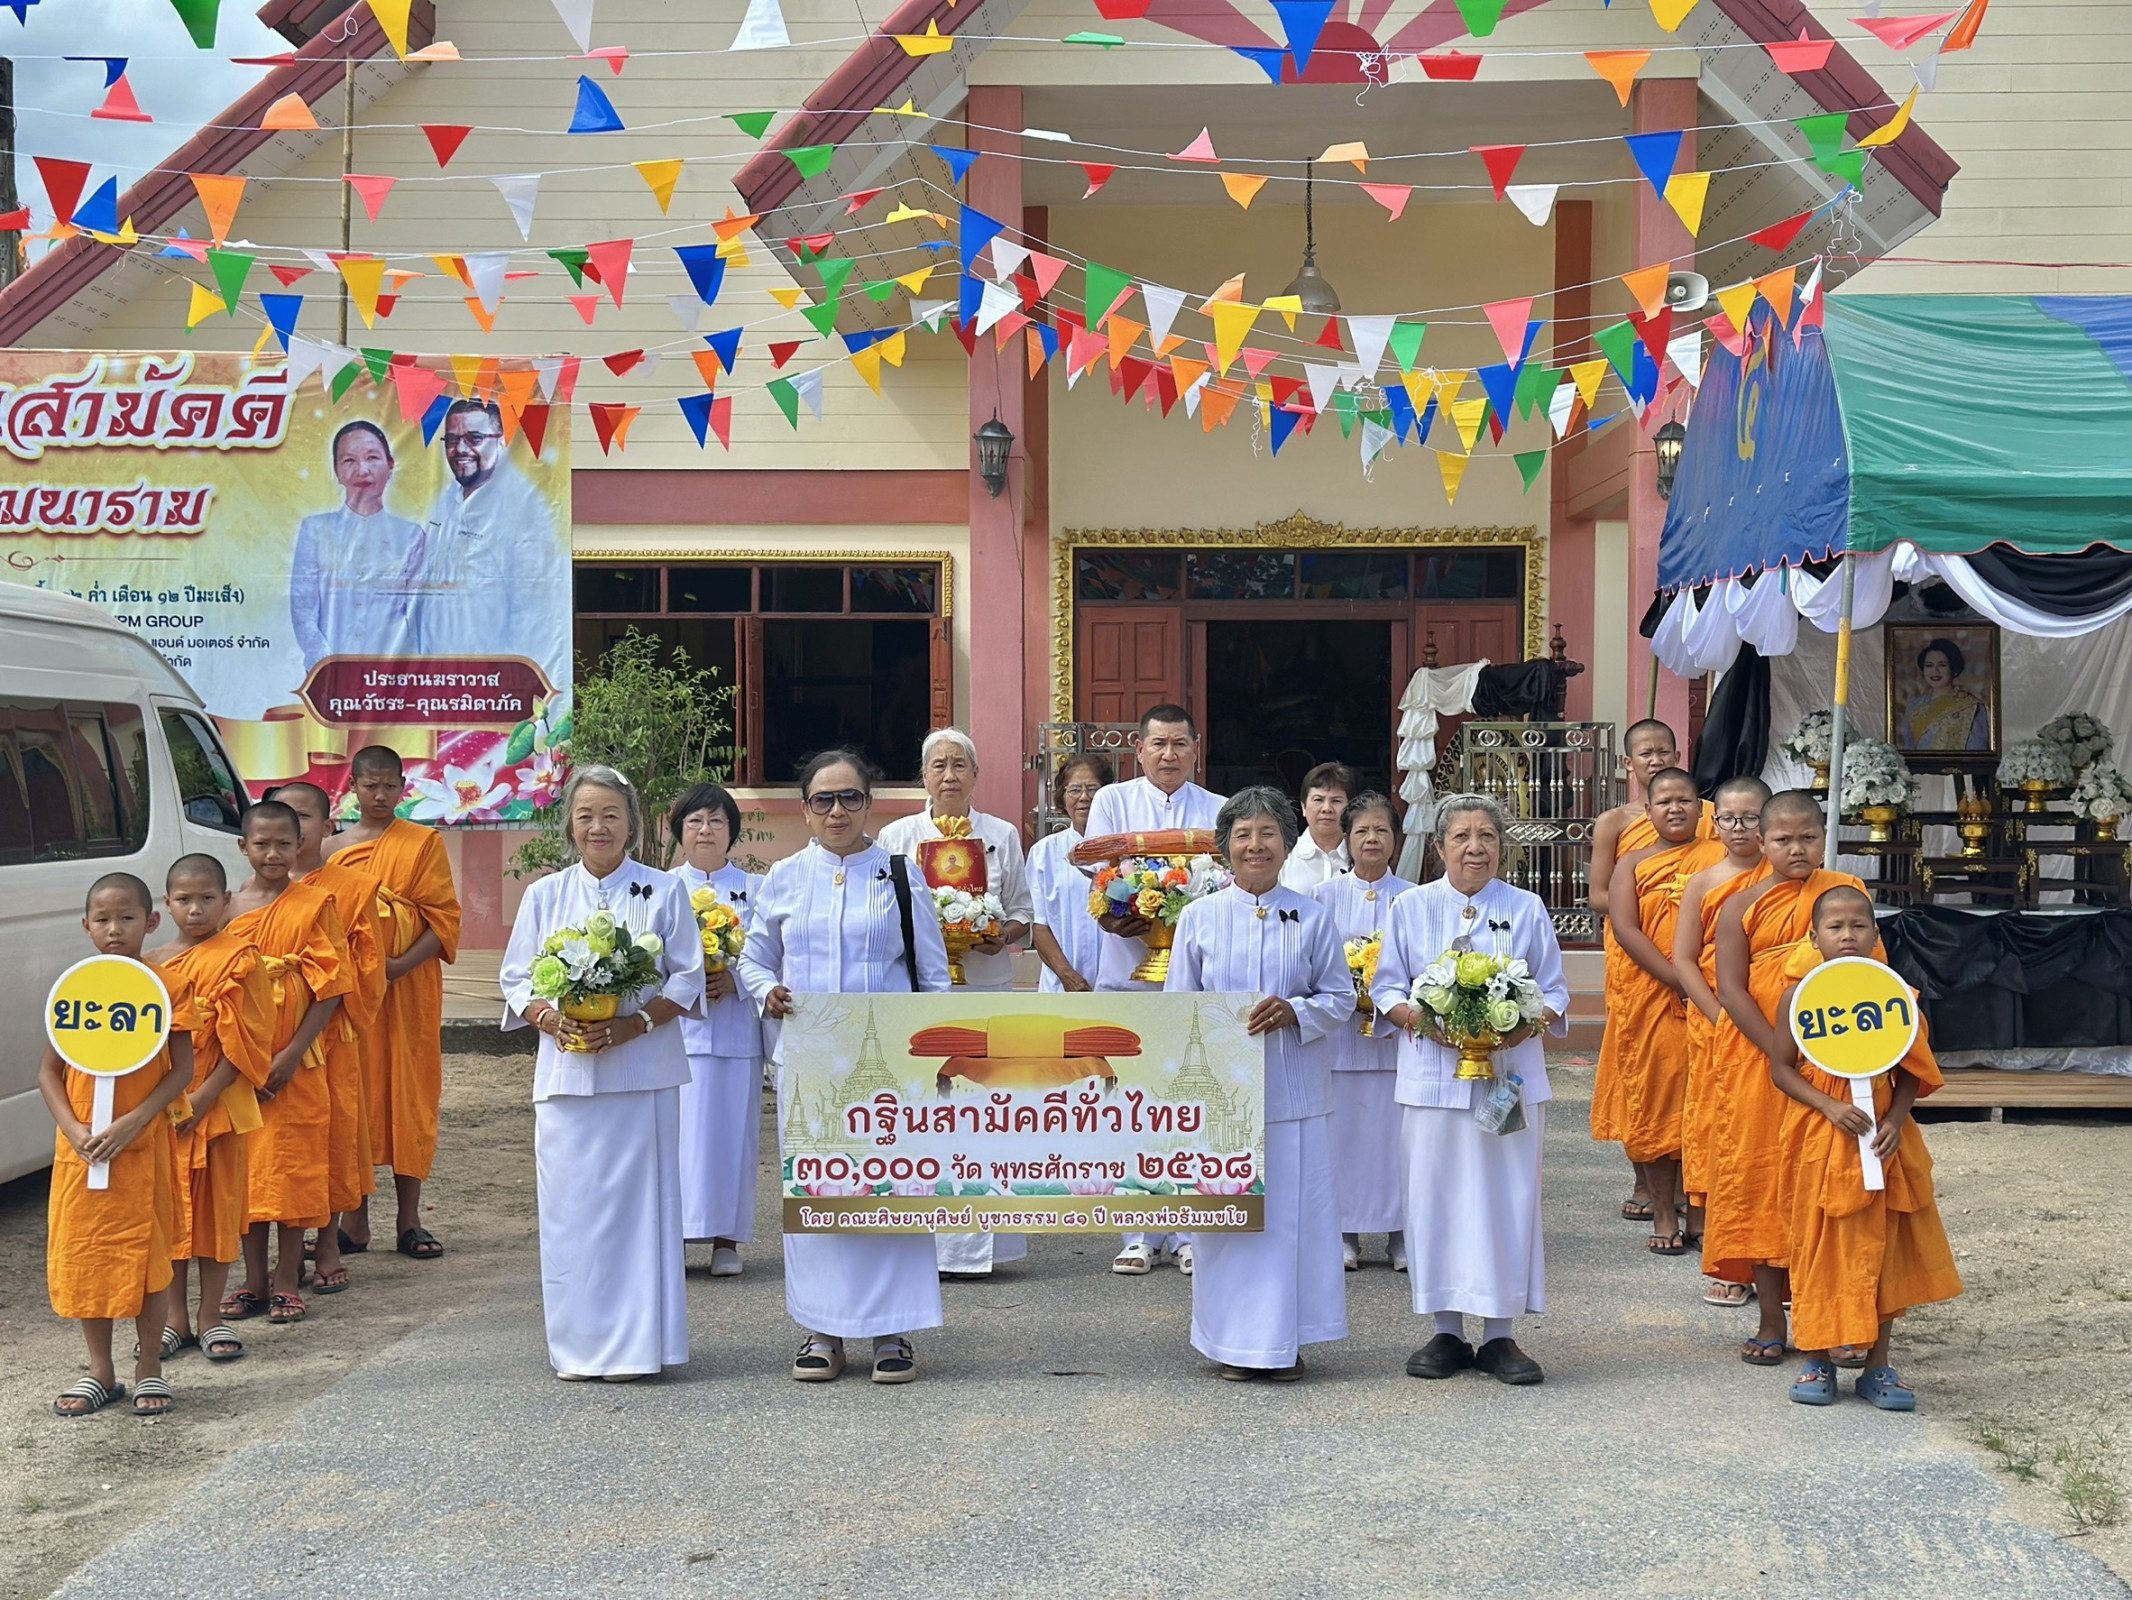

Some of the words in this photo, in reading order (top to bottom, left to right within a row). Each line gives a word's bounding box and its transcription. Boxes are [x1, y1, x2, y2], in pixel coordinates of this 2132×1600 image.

[88, 580, 107, 603] ค่ำ
[113, 584, 152, 603] เดือน
[158, 590, 179, 605] ๑๒
[185, 584, 244, 605] ปีมะเส็ง)
[146, 615, 204, 628] GROUP
[187, 635, 234, 649] มอเตอร์
[237, 635, 270, 649] จำกัด
[363, 671, 501, 687] ประธานฆราวาส
[54, 1000, 162, 1033] ยะลา
[1798, 997, 1911, 1040] ยะลา
[847, 1081, 1201, 1146] กฐินสามัคคีทั่วไทย
[797, 1157, 940, 1184] ๓๐,๐๐๐
[951, 1154, 982, 1180] วัด
[990, 1154, 1126, 1189] พุทธศักราช
[1137, 1151, 1252, 1180] ๒๕๖๘
[802, 1208, 832, 1226] โดย
[840, 1206, 971, 1231] คณะศิษยานุศิษย์
[979, 1212, 1056, 1230] บูชาธรรม
[1063, 1211, 1087, 1226] ๘๑
[1094, 1207, 1106, 1225] ปี
